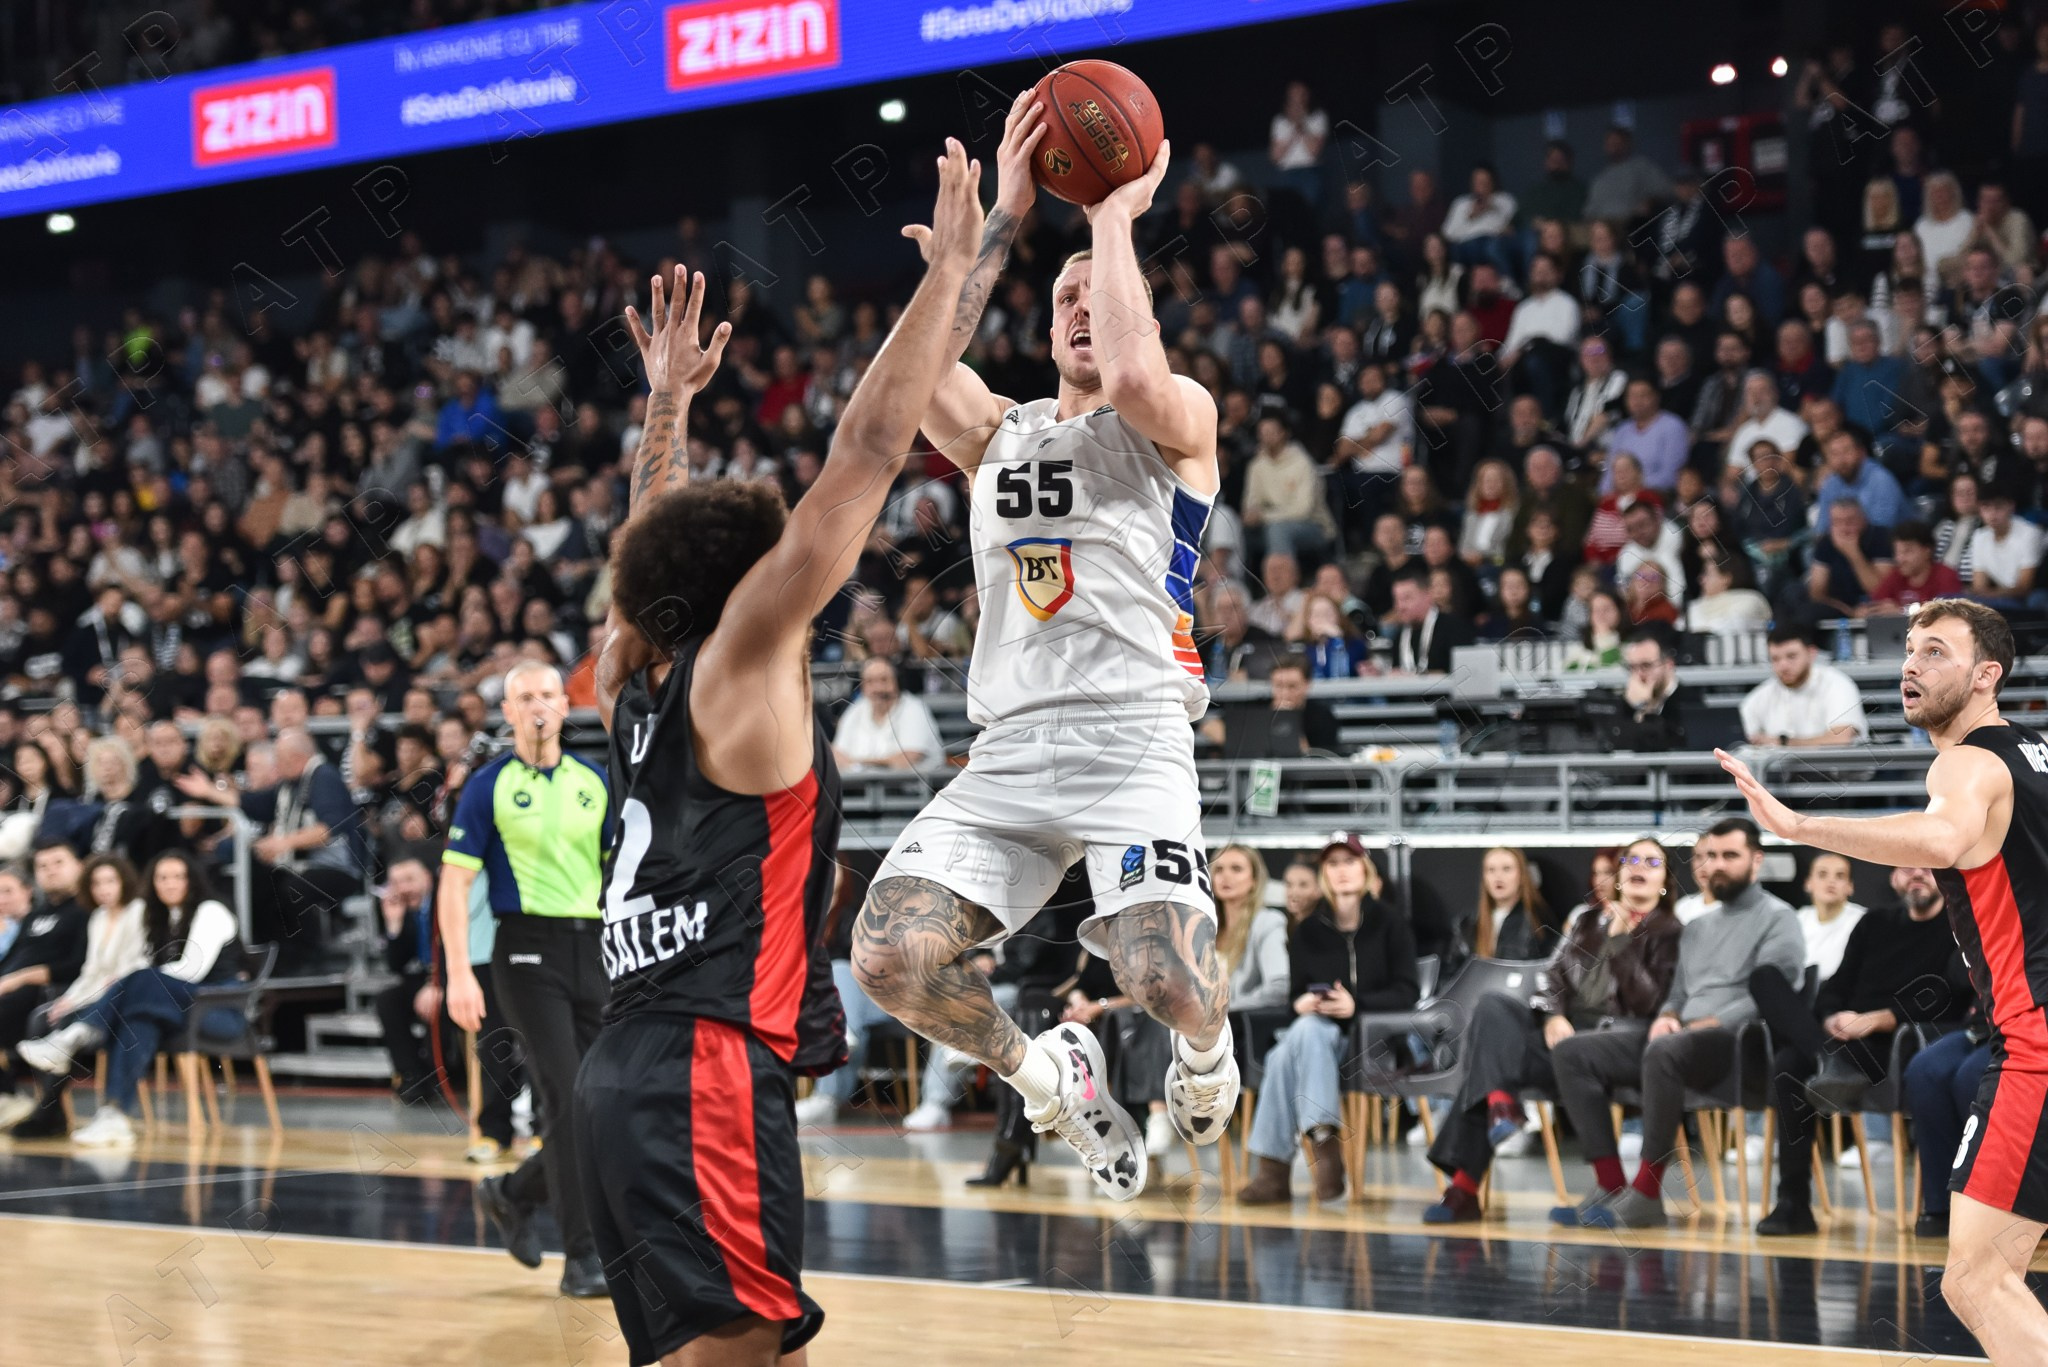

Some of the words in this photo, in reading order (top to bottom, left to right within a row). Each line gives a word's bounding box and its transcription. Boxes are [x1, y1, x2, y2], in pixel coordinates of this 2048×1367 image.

[1067, 101, 1125, 174] LEGACY
[996, 459, 1073, 519] 55
[1024, 556, 1058, 581] BT
